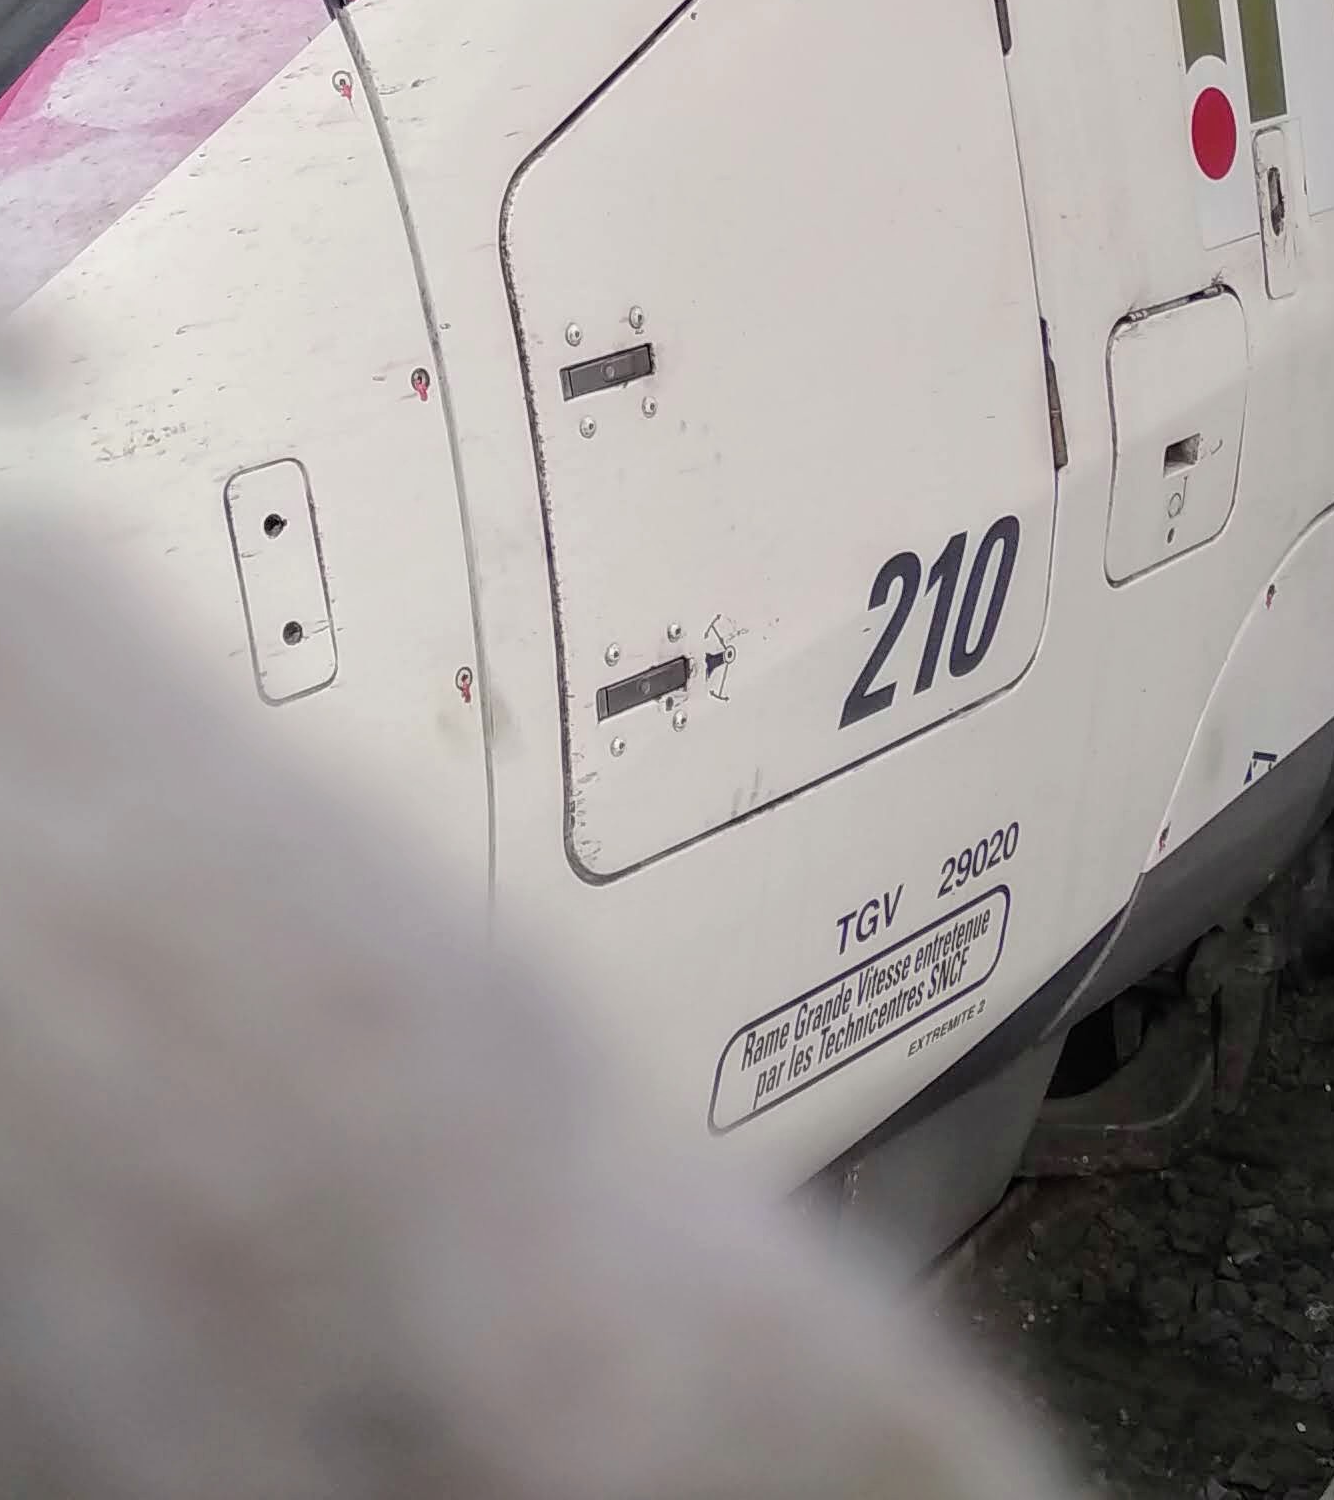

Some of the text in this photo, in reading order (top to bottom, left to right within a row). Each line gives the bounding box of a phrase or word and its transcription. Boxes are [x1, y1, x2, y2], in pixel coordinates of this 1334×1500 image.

[837, 514, 1021, 731] 210
[836, 821, 1020, 956] TGV 29020
[741, 908, 991, 1072] Rame Grande Vitesse entretenue
[753, 946, 970, 1111] par les Technicentres SNCF
[907, 998, 987, 1058] EXTREMITE 2
